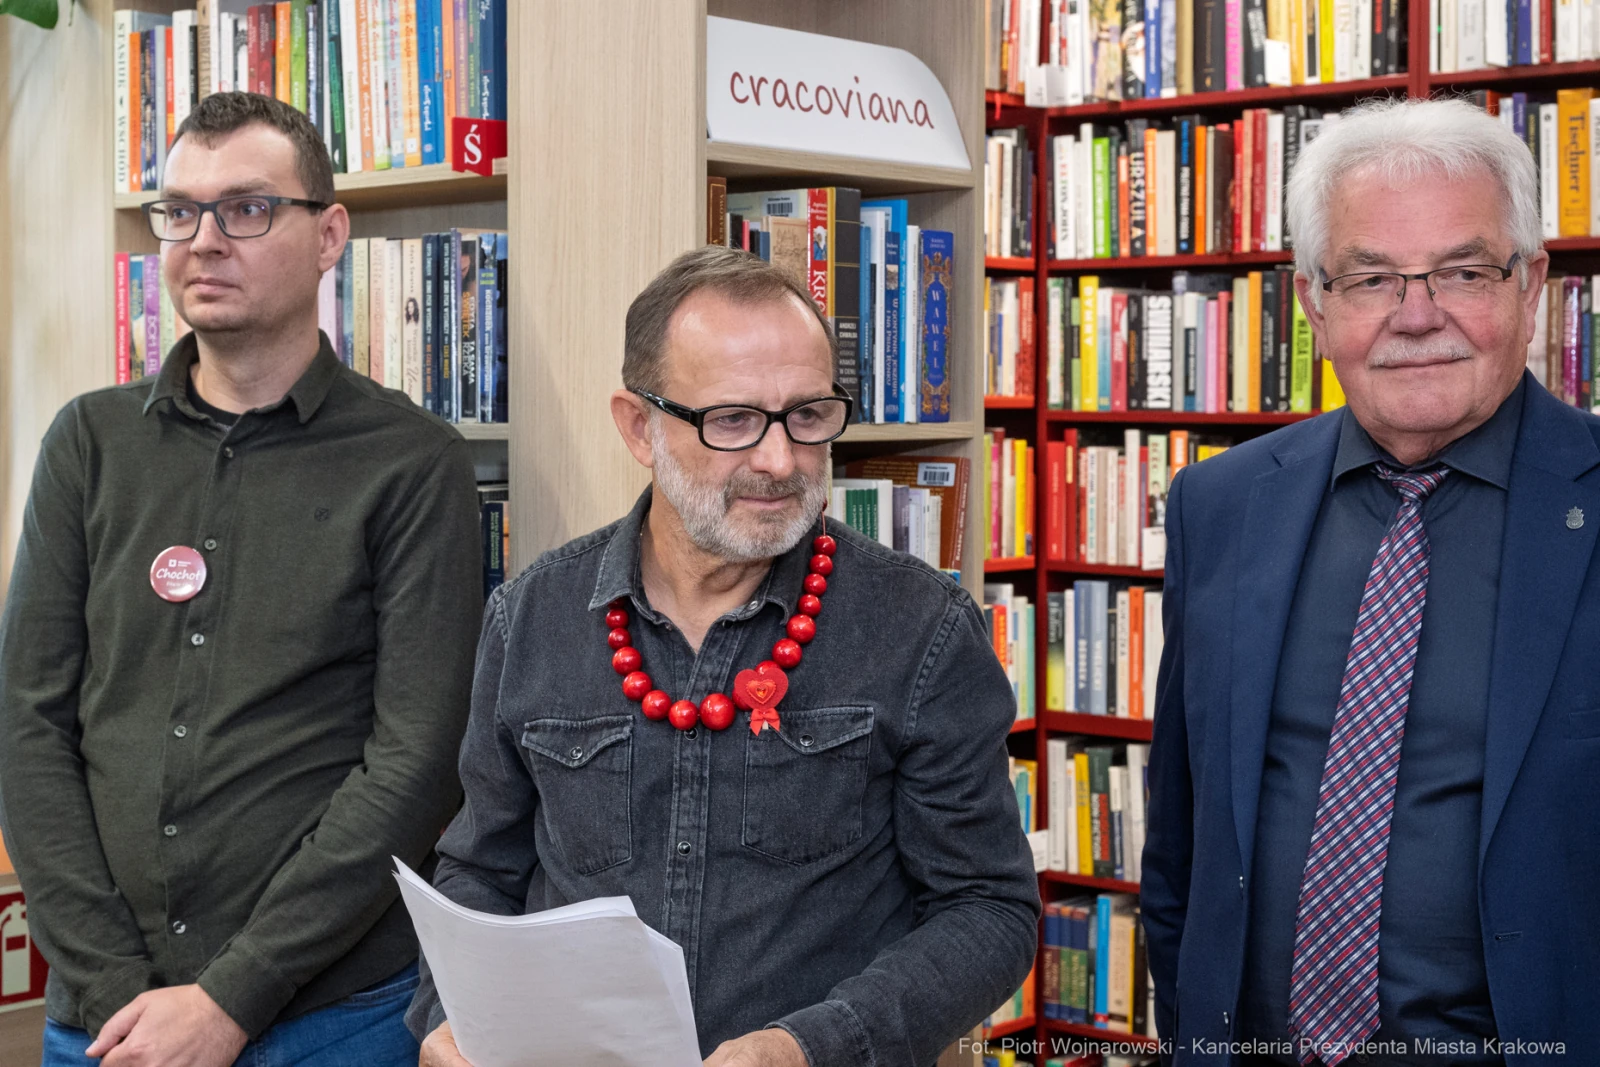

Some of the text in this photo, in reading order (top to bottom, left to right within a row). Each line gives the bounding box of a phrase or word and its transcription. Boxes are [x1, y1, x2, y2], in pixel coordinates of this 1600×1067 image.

[200, 25, 211, 73] ANDRZEJ
[117, 23, 130, 182] STASIUK WSCHÓD
[729, 71, 935, 130] cracoviana
[464, 124, 482, 164] Ś
[1568, 111, 1587, 194] Tischner
[718, 194, 726, 240] KRAKOWA
[1129, 151, 1146, 241] URSZULA
[147, 315, 158, 346] DOM
[461, 291, 471, 338] ŚWIĘTEK
[484, 289, 493, 331] Kochanek
[930, 289, 941, 369] WAWEL
[462, 341, 470, 376] RZEKA
